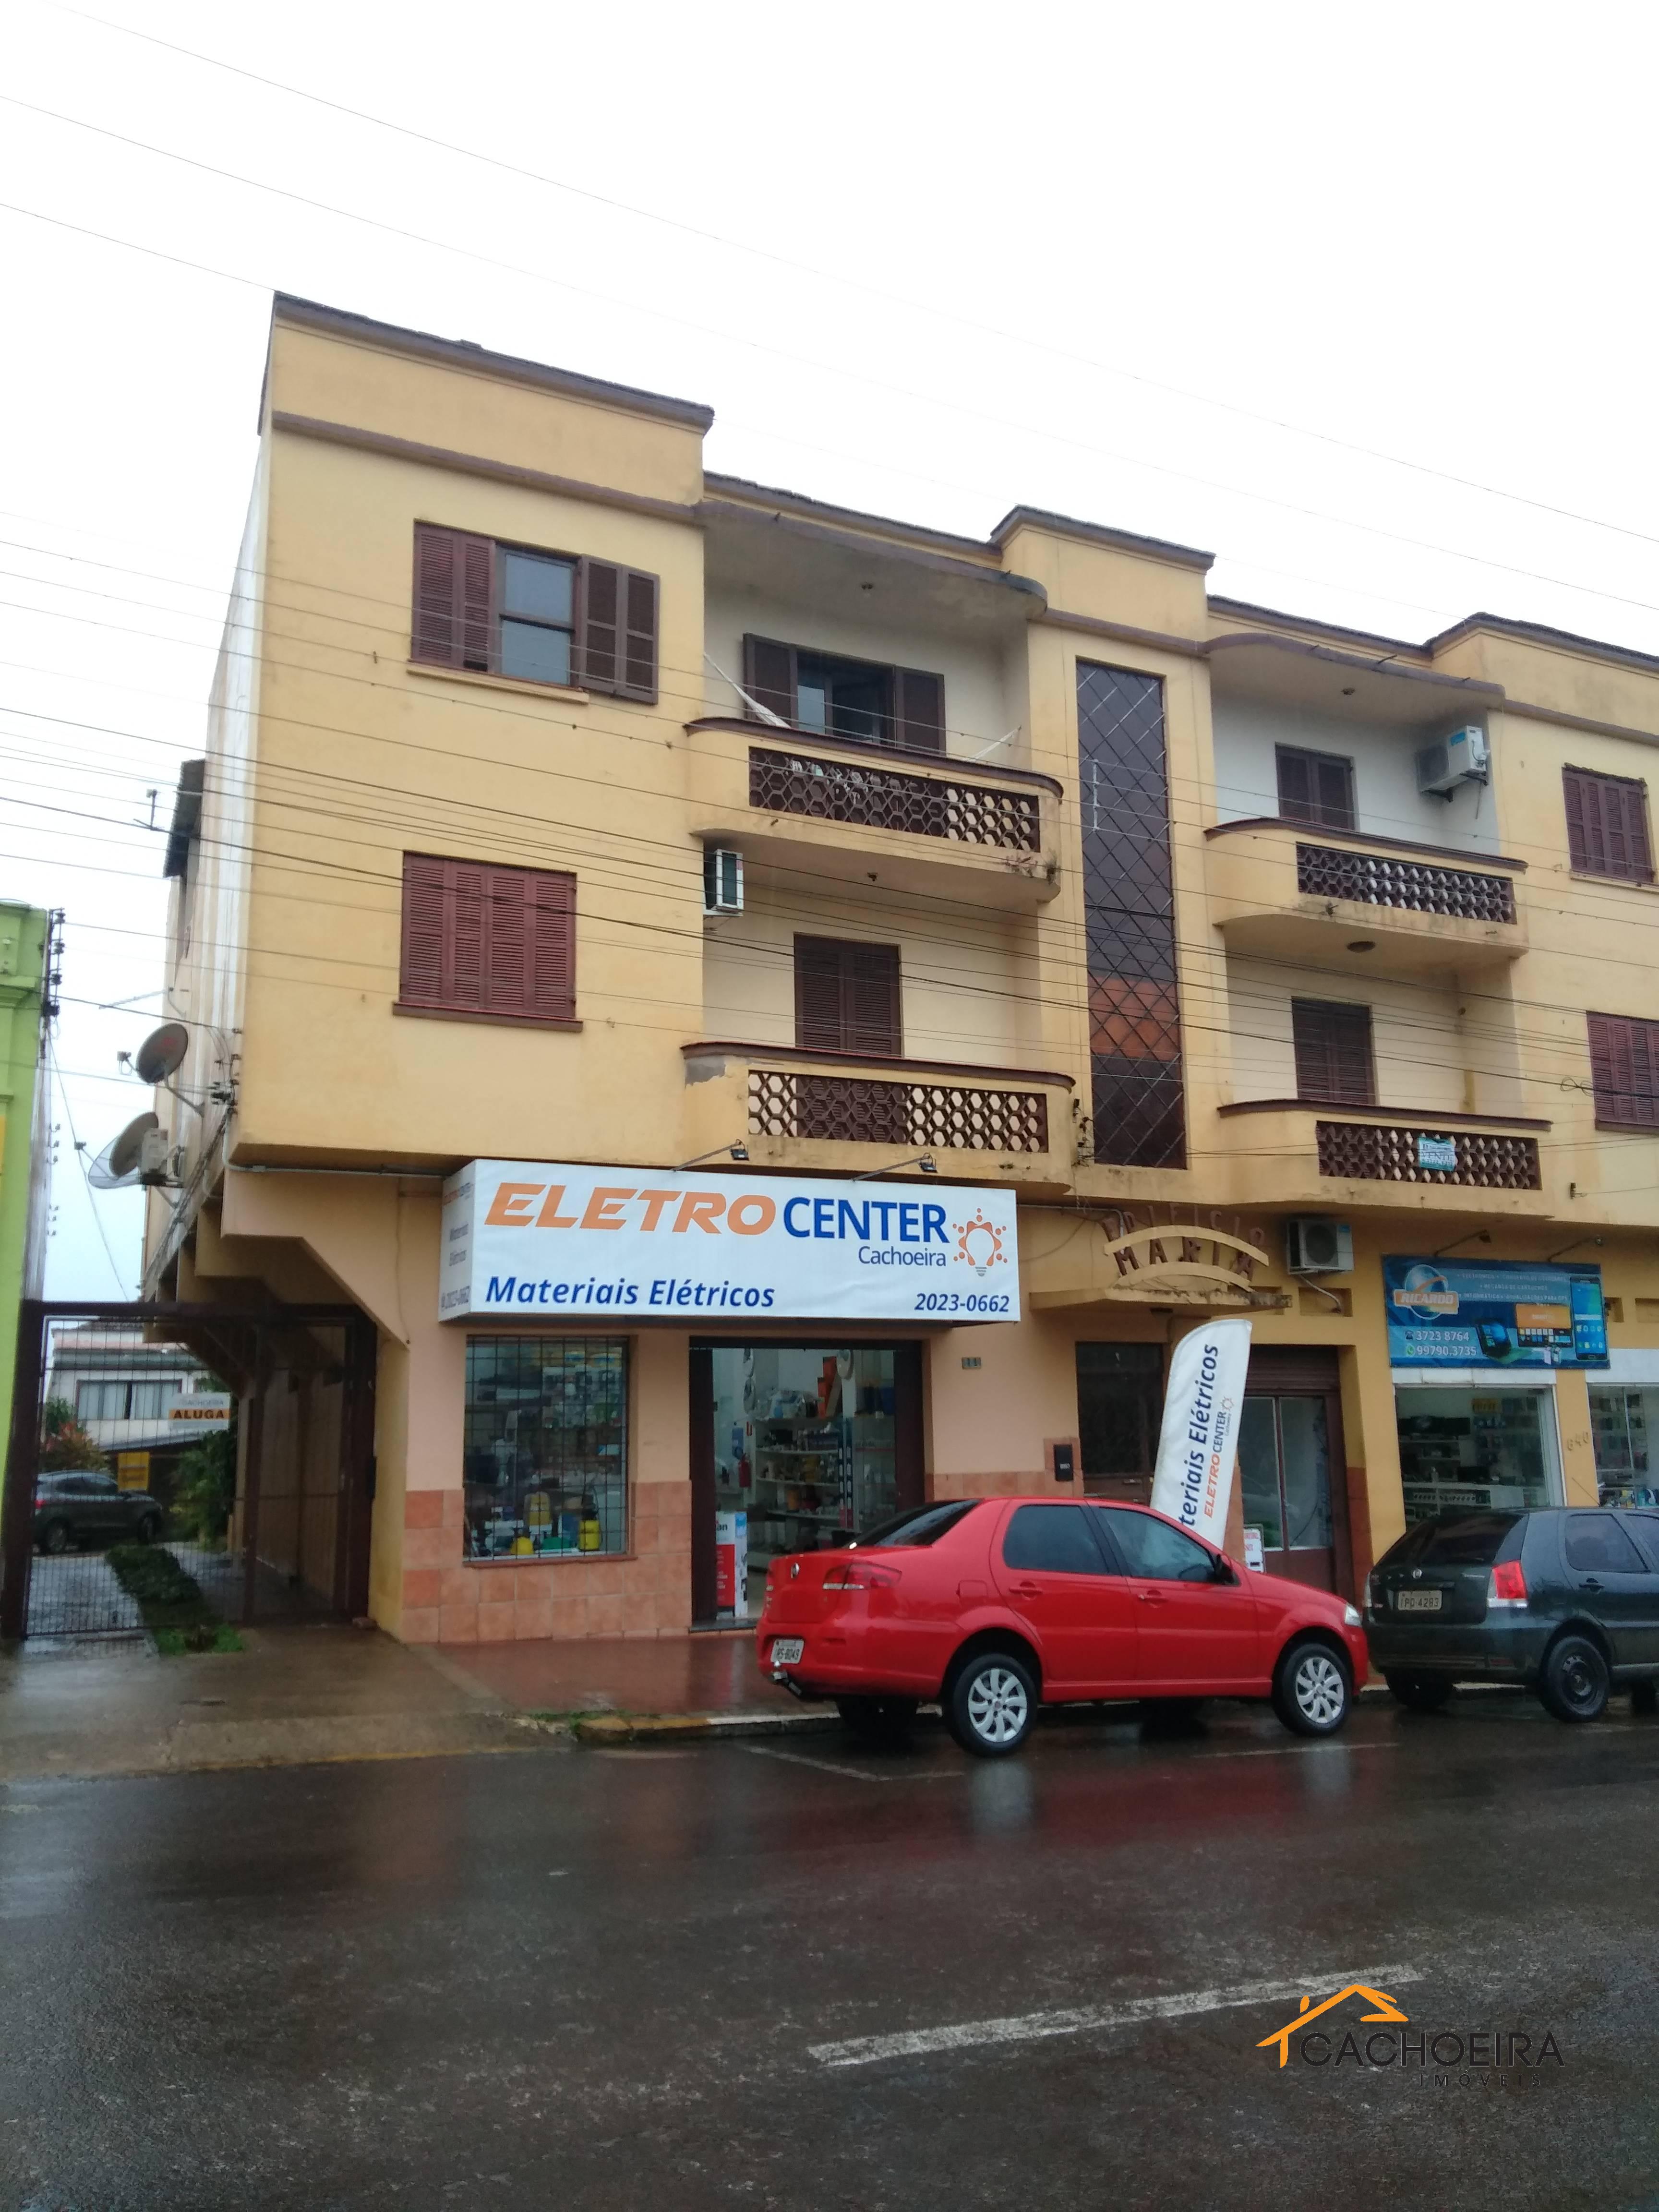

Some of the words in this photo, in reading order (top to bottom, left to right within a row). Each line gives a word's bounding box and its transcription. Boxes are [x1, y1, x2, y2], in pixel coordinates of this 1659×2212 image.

[484, 1182, 776, 1235] ELETRO
[783, 1197, 950, 1243] CENTER
[858, 1246, 946, 1266] Cachoeira
[485, 1276, 638, 1305] Materiais
[649, 1279, 775, 1307] Elétricos
[1401, 1293, 1454, 1304] RICARDO
[914, 1293, 1010, 1312] 2023-0662
[1416, 1330, 1441, 1341] 3723
[1444, 1331, 1469, 1341] 8764
[1417, 1345, 1477, 1356] 99790.3735
[1189, 1344, 1218, 1445] Elétricos
[173, 1409, 224, 1419] ALUGA
[1213, 1411, 1226, 1454] CENTER
[1178, 1451, 1204, 1526] teriais
